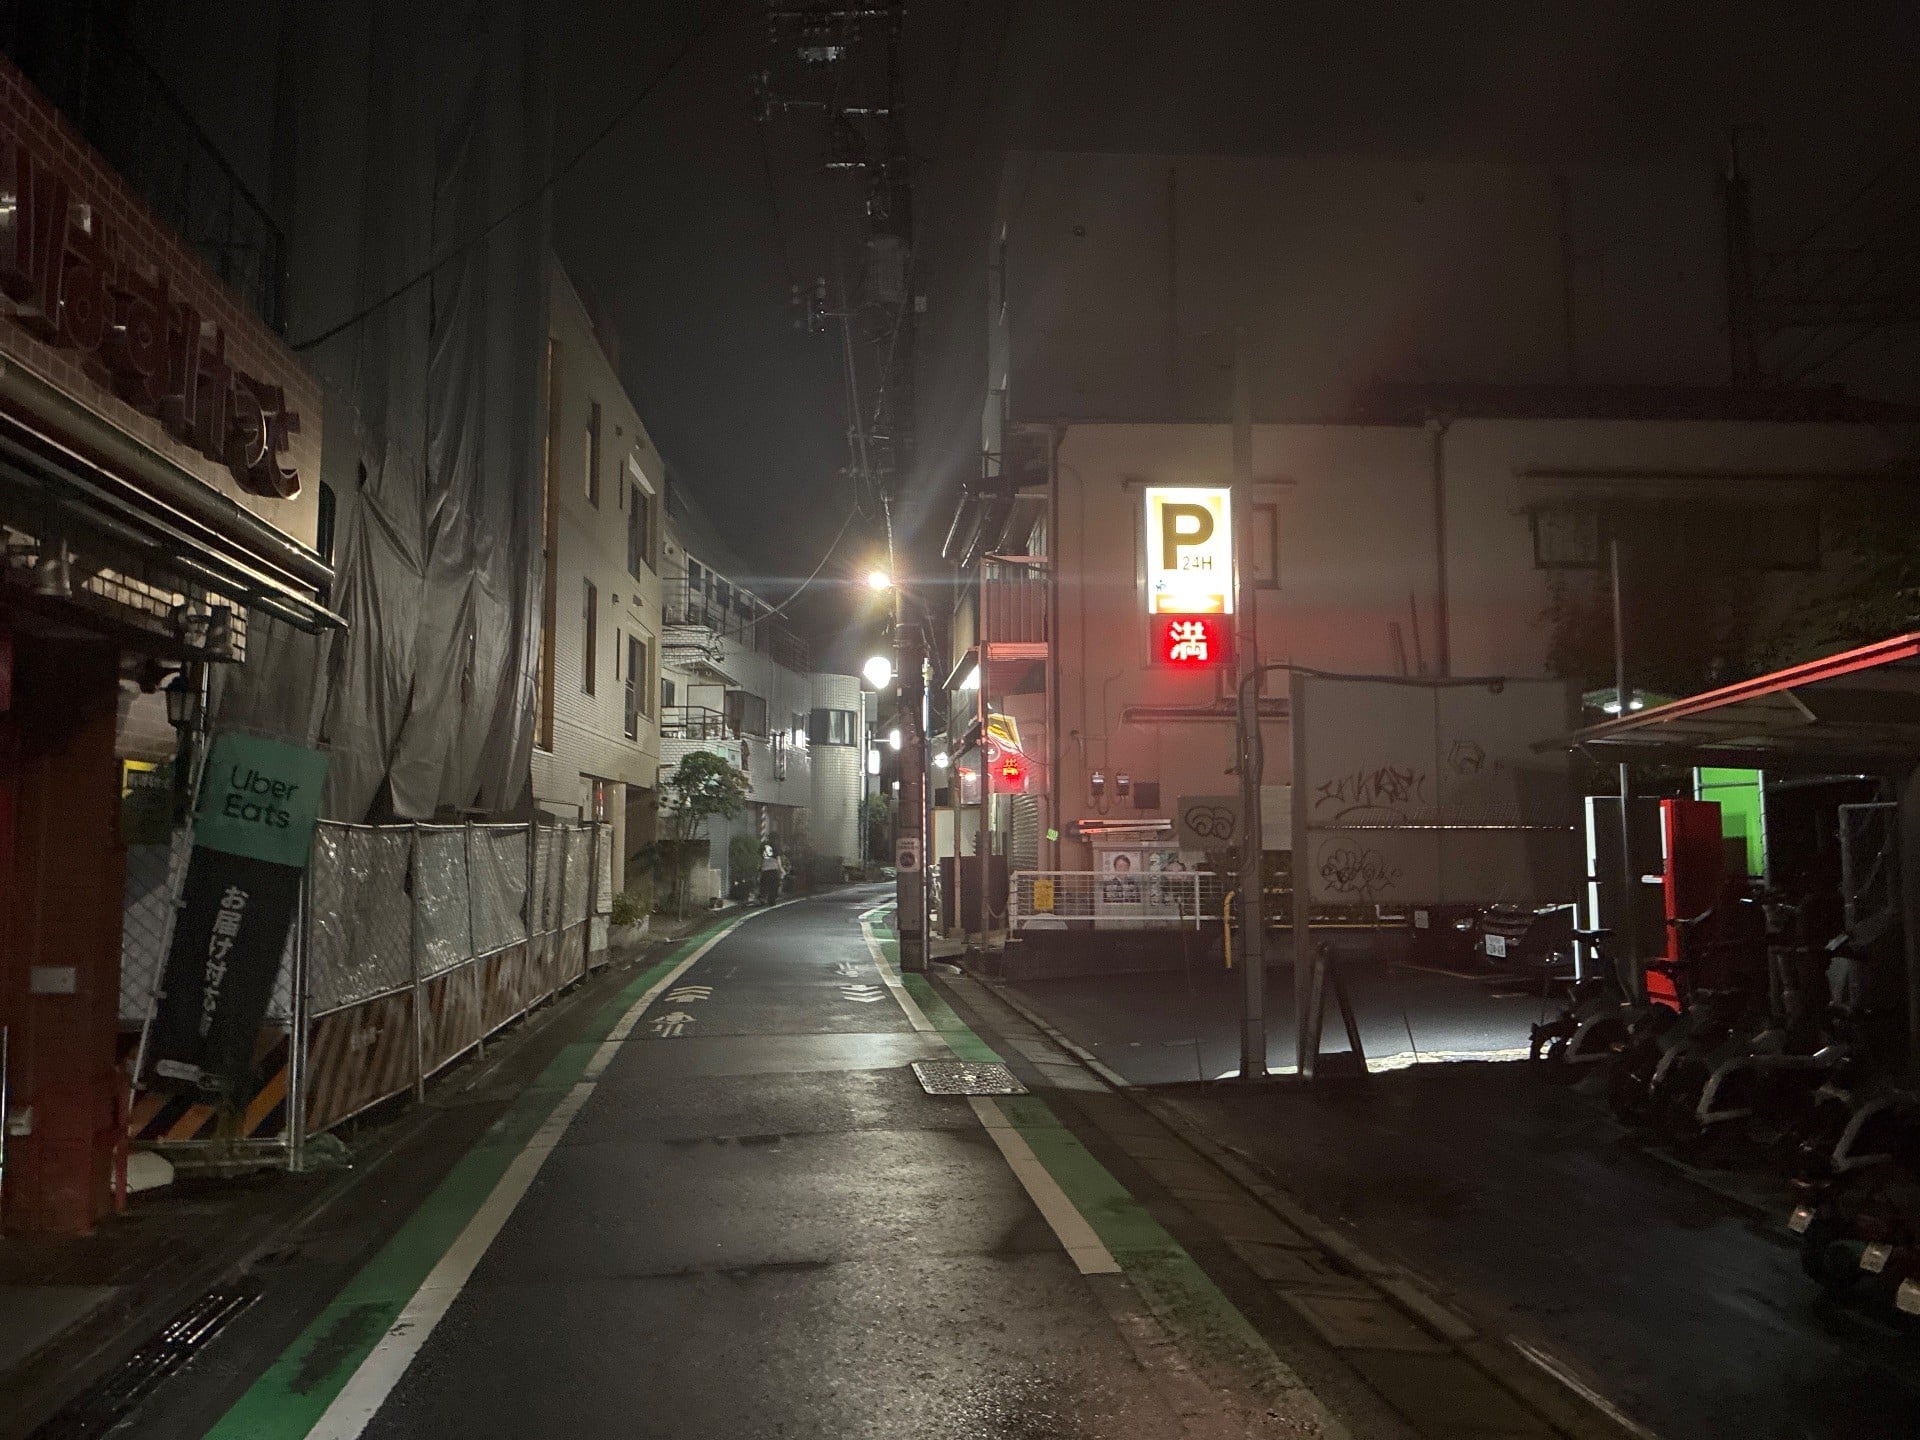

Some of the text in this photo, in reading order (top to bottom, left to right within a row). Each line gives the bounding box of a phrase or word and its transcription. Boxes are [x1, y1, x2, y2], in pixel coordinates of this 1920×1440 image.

[1162, 503, 1214, 570] P
[1170, 621, 1208, 660] 満
[231, 765, 299, 800] Uber
[222, 792, 290, 829] Eats
